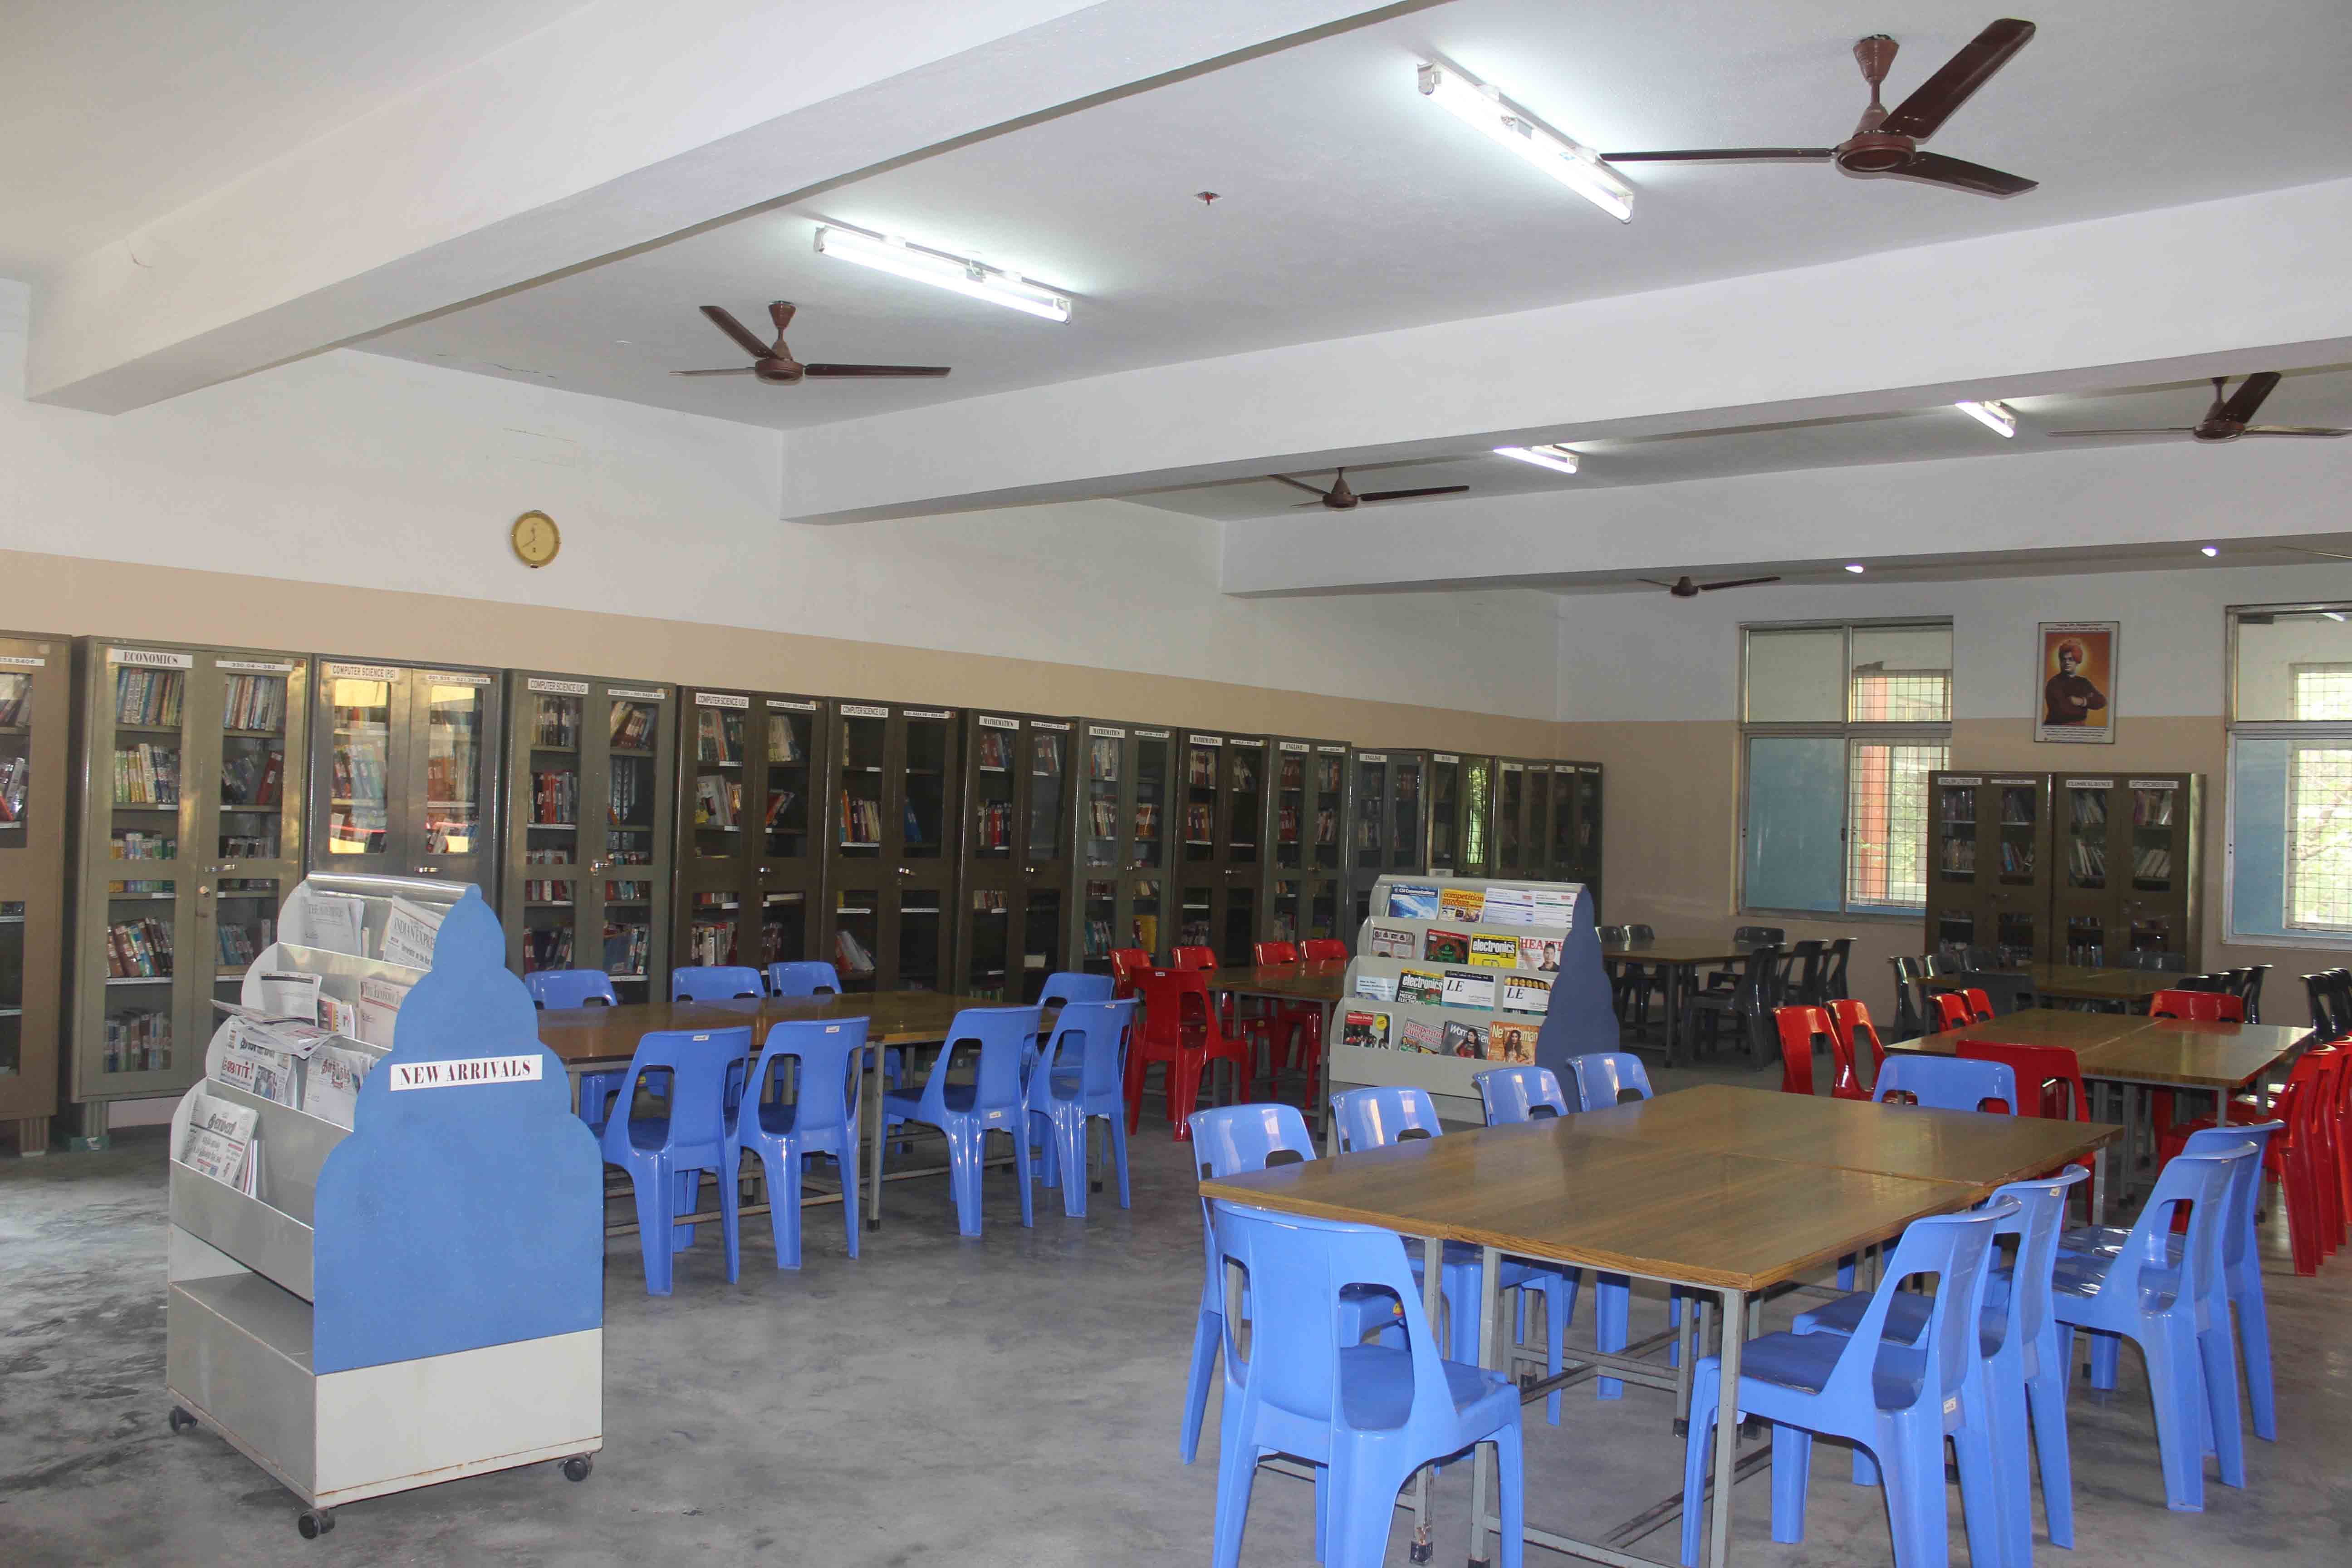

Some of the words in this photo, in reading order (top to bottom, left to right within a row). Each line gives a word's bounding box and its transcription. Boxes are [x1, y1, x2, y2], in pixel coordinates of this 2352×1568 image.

[123, 652, 178, 664] ECONOMICS
[333, 665, 361, 676] COMPUTER
[362, 667, 384, 678] SCIENCE
[530, 680, 557, 691] COMPUTER
[557, 681, 575, 692] SCIENCE
[984, 717, 1014, 727] MATHEMATICS
[1443, 892, 1484, 902] competition
[395, 917, 414, 939] INDIAN
[1473, 939, 1515, 953] electronics
[1402, 975, 1443, 991] electronics
[1446, 980, 1464, 992] LE
[1507, 988, 1525, 999] LE
[399, 1065, 441, 1085] NEW
[446, 1059, 531, 1082] ARRIVALS
